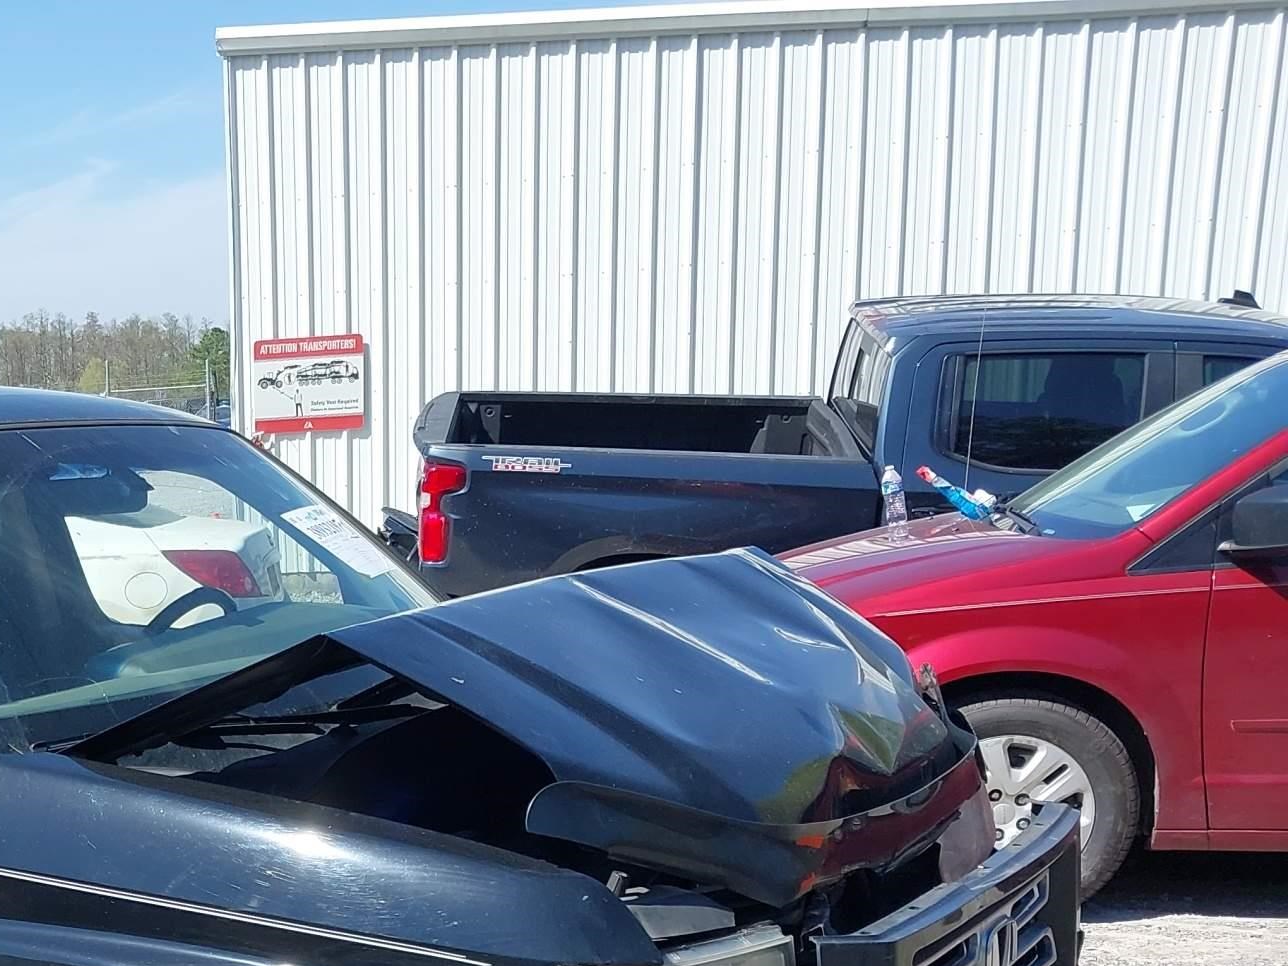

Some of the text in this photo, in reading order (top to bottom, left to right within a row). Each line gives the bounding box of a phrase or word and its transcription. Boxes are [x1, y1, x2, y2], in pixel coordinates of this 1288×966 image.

[260, 339, 356, 355] ATTENTION TRANSPORTERS!
[493, 464, 560, 472] BOSS
